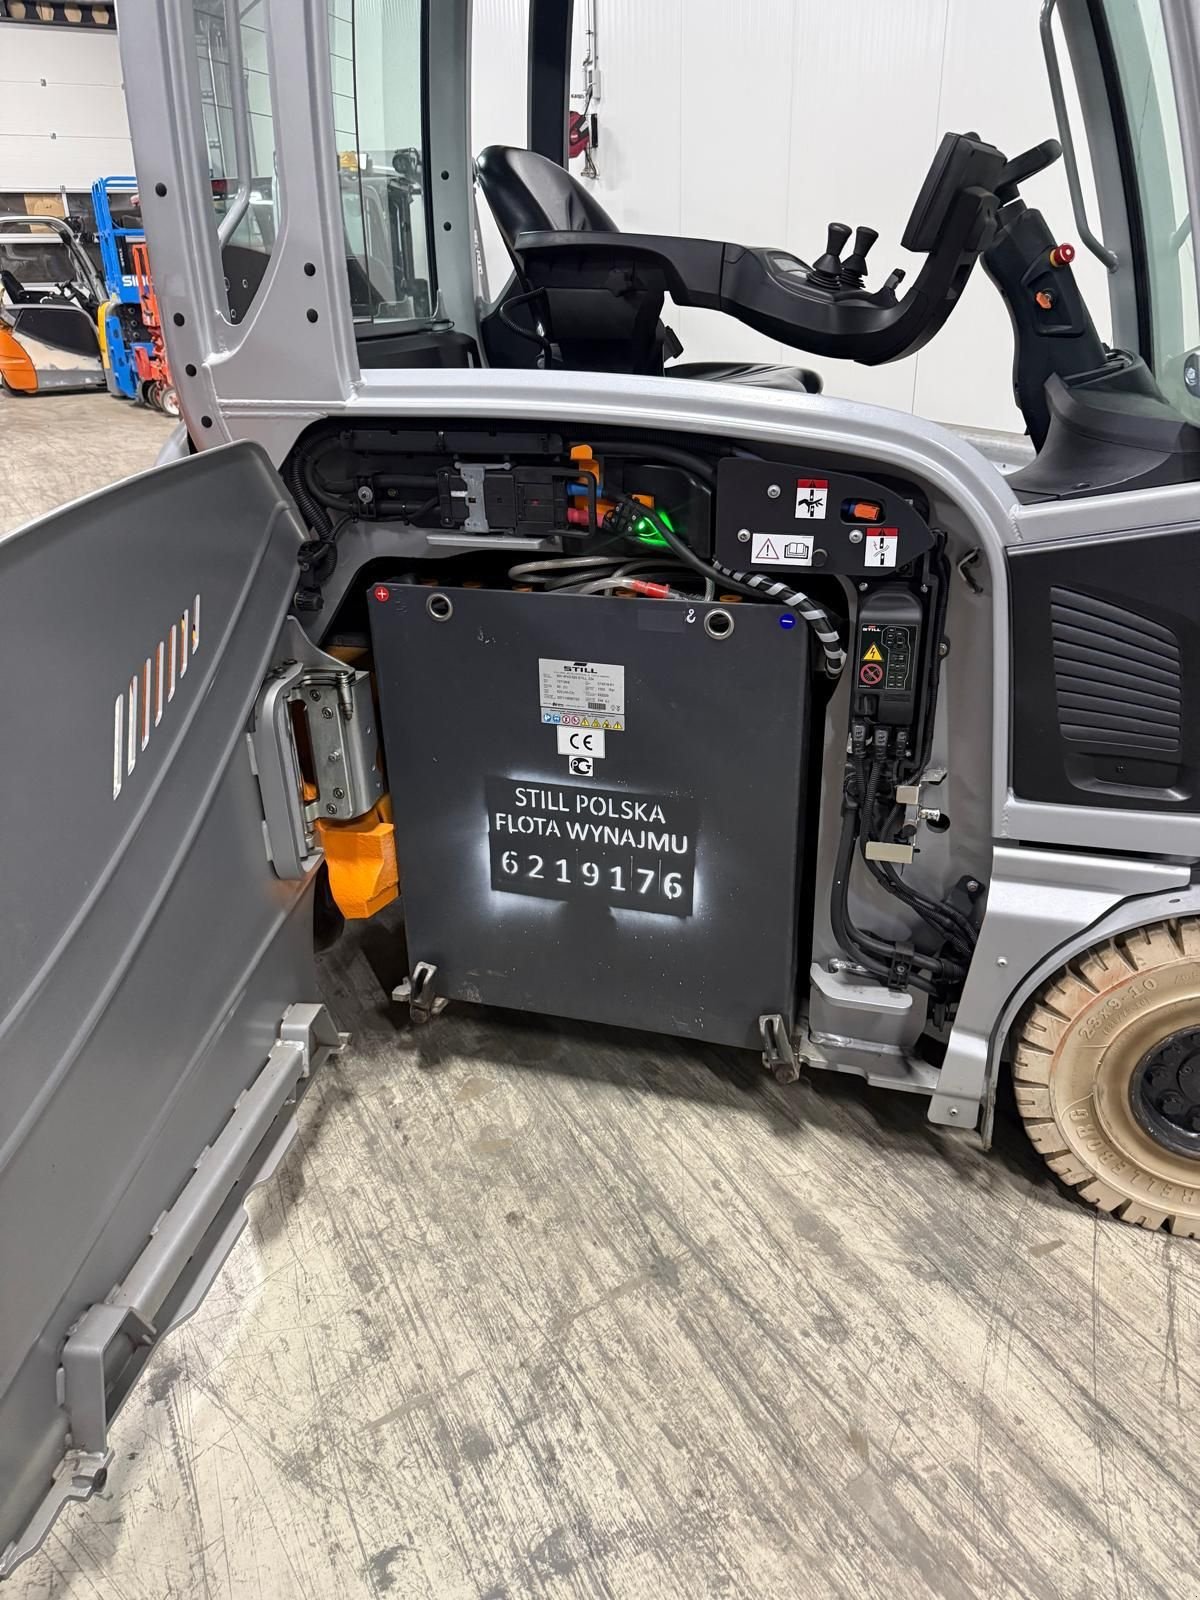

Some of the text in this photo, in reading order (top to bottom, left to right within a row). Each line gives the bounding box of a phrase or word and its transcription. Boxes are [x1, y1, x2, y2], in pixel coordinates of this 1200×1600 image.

[563, 665, 598, 674] STILL
[569, 733, 593, 751] CE
[515, 787, 666, 824] STILL POLSKA
[495, 813, 688, 854] FLOTA WYNAJMU
[502, 850, 682, 900] 6219176
[1068, 1108, 1196, 1203] RELLEBORG
